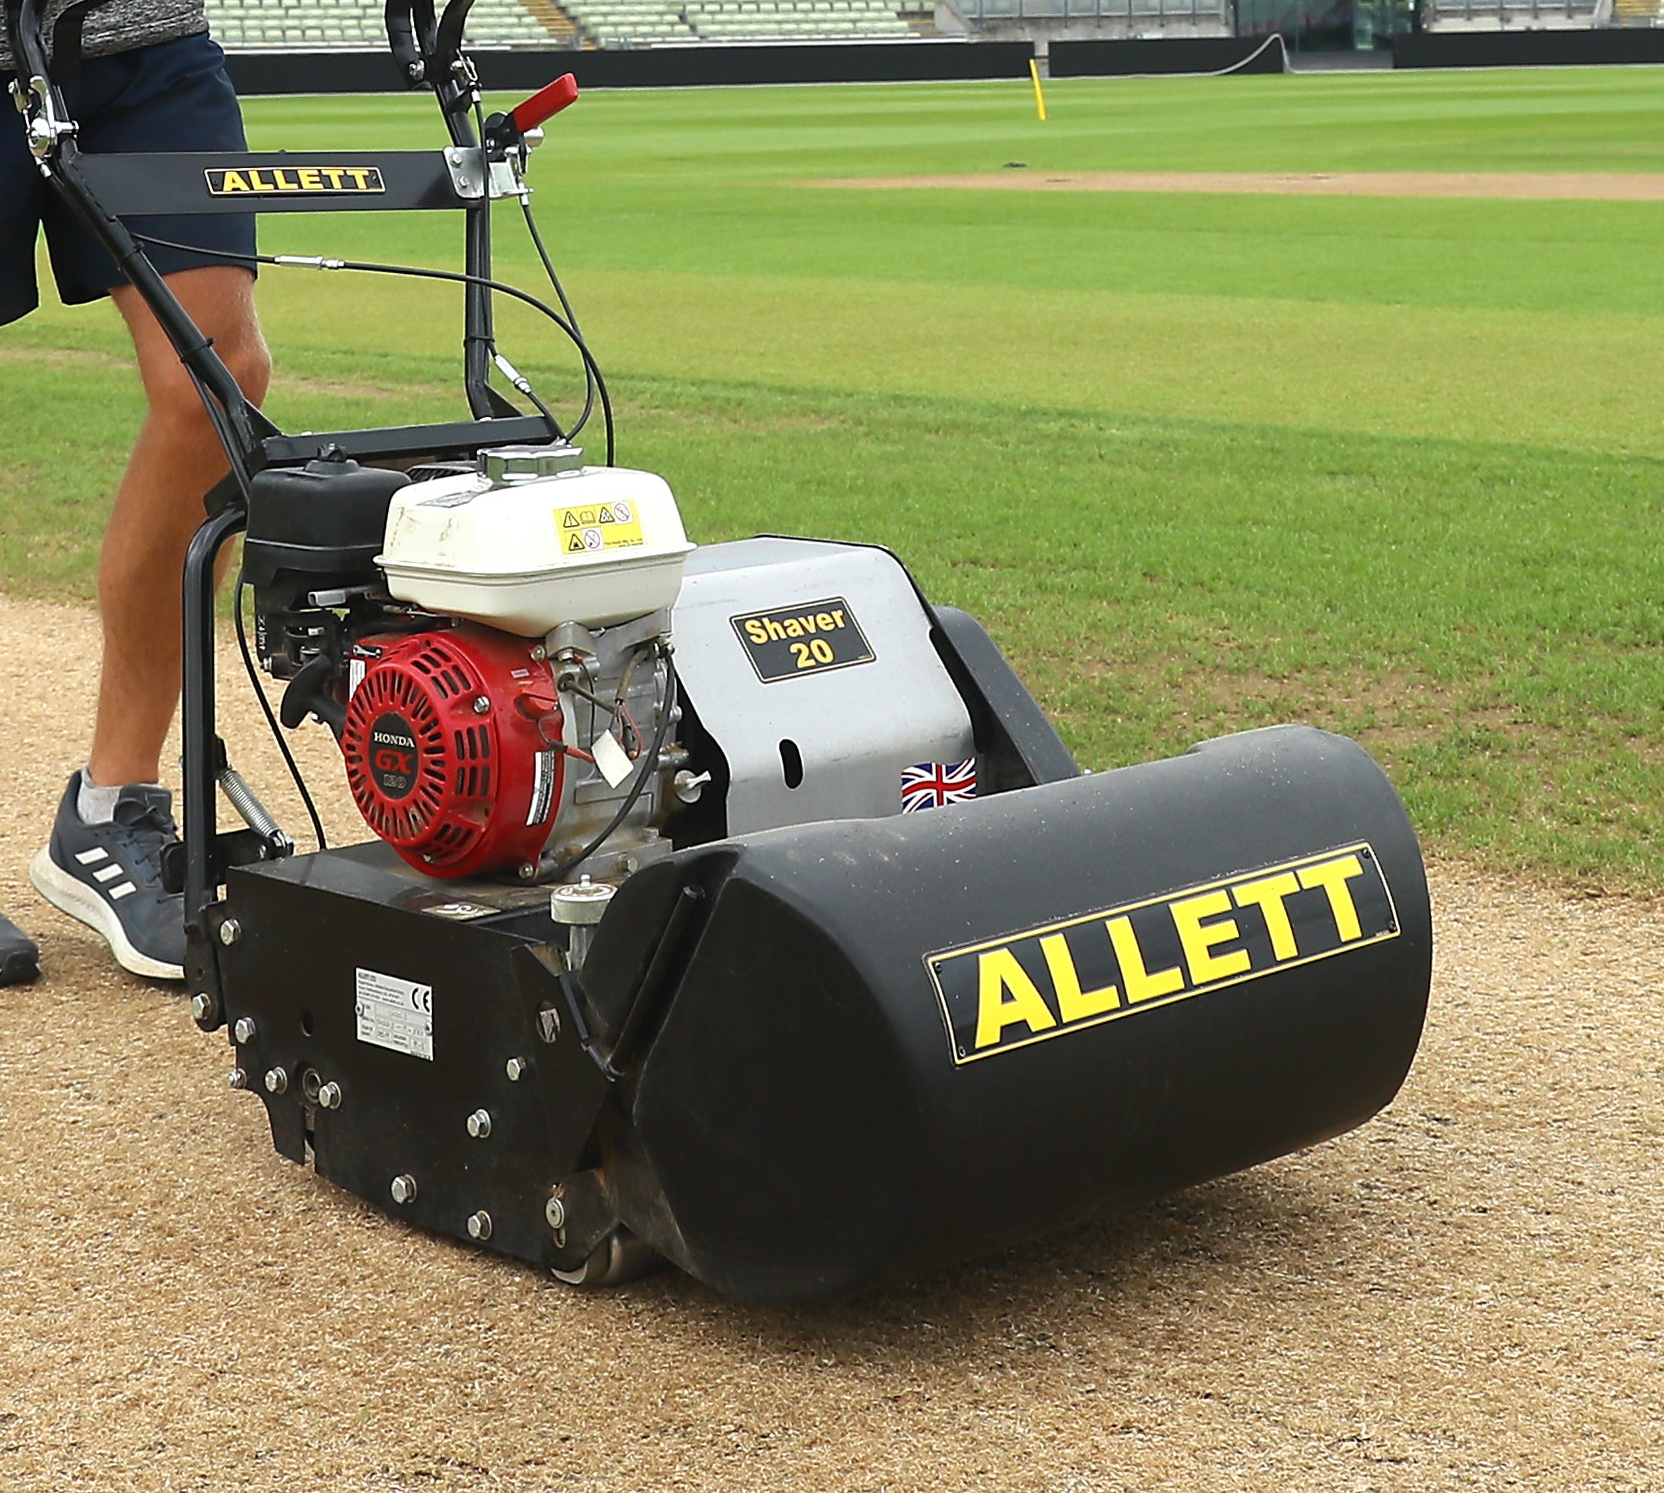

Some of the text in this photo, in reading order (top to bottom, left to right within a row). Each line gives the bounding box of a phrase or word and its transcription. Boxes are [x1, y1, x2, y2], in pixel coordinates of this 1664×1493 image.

[223, 169, 369, 192] ALLETT
[744, 609, 846, 644] Shaver
[789, 639, 834, 669] 20
[374, 732, 415, 748] HONDA
[375, 749, 413, 775] GX
[974, 854, 1364, 1049] ALLETT
